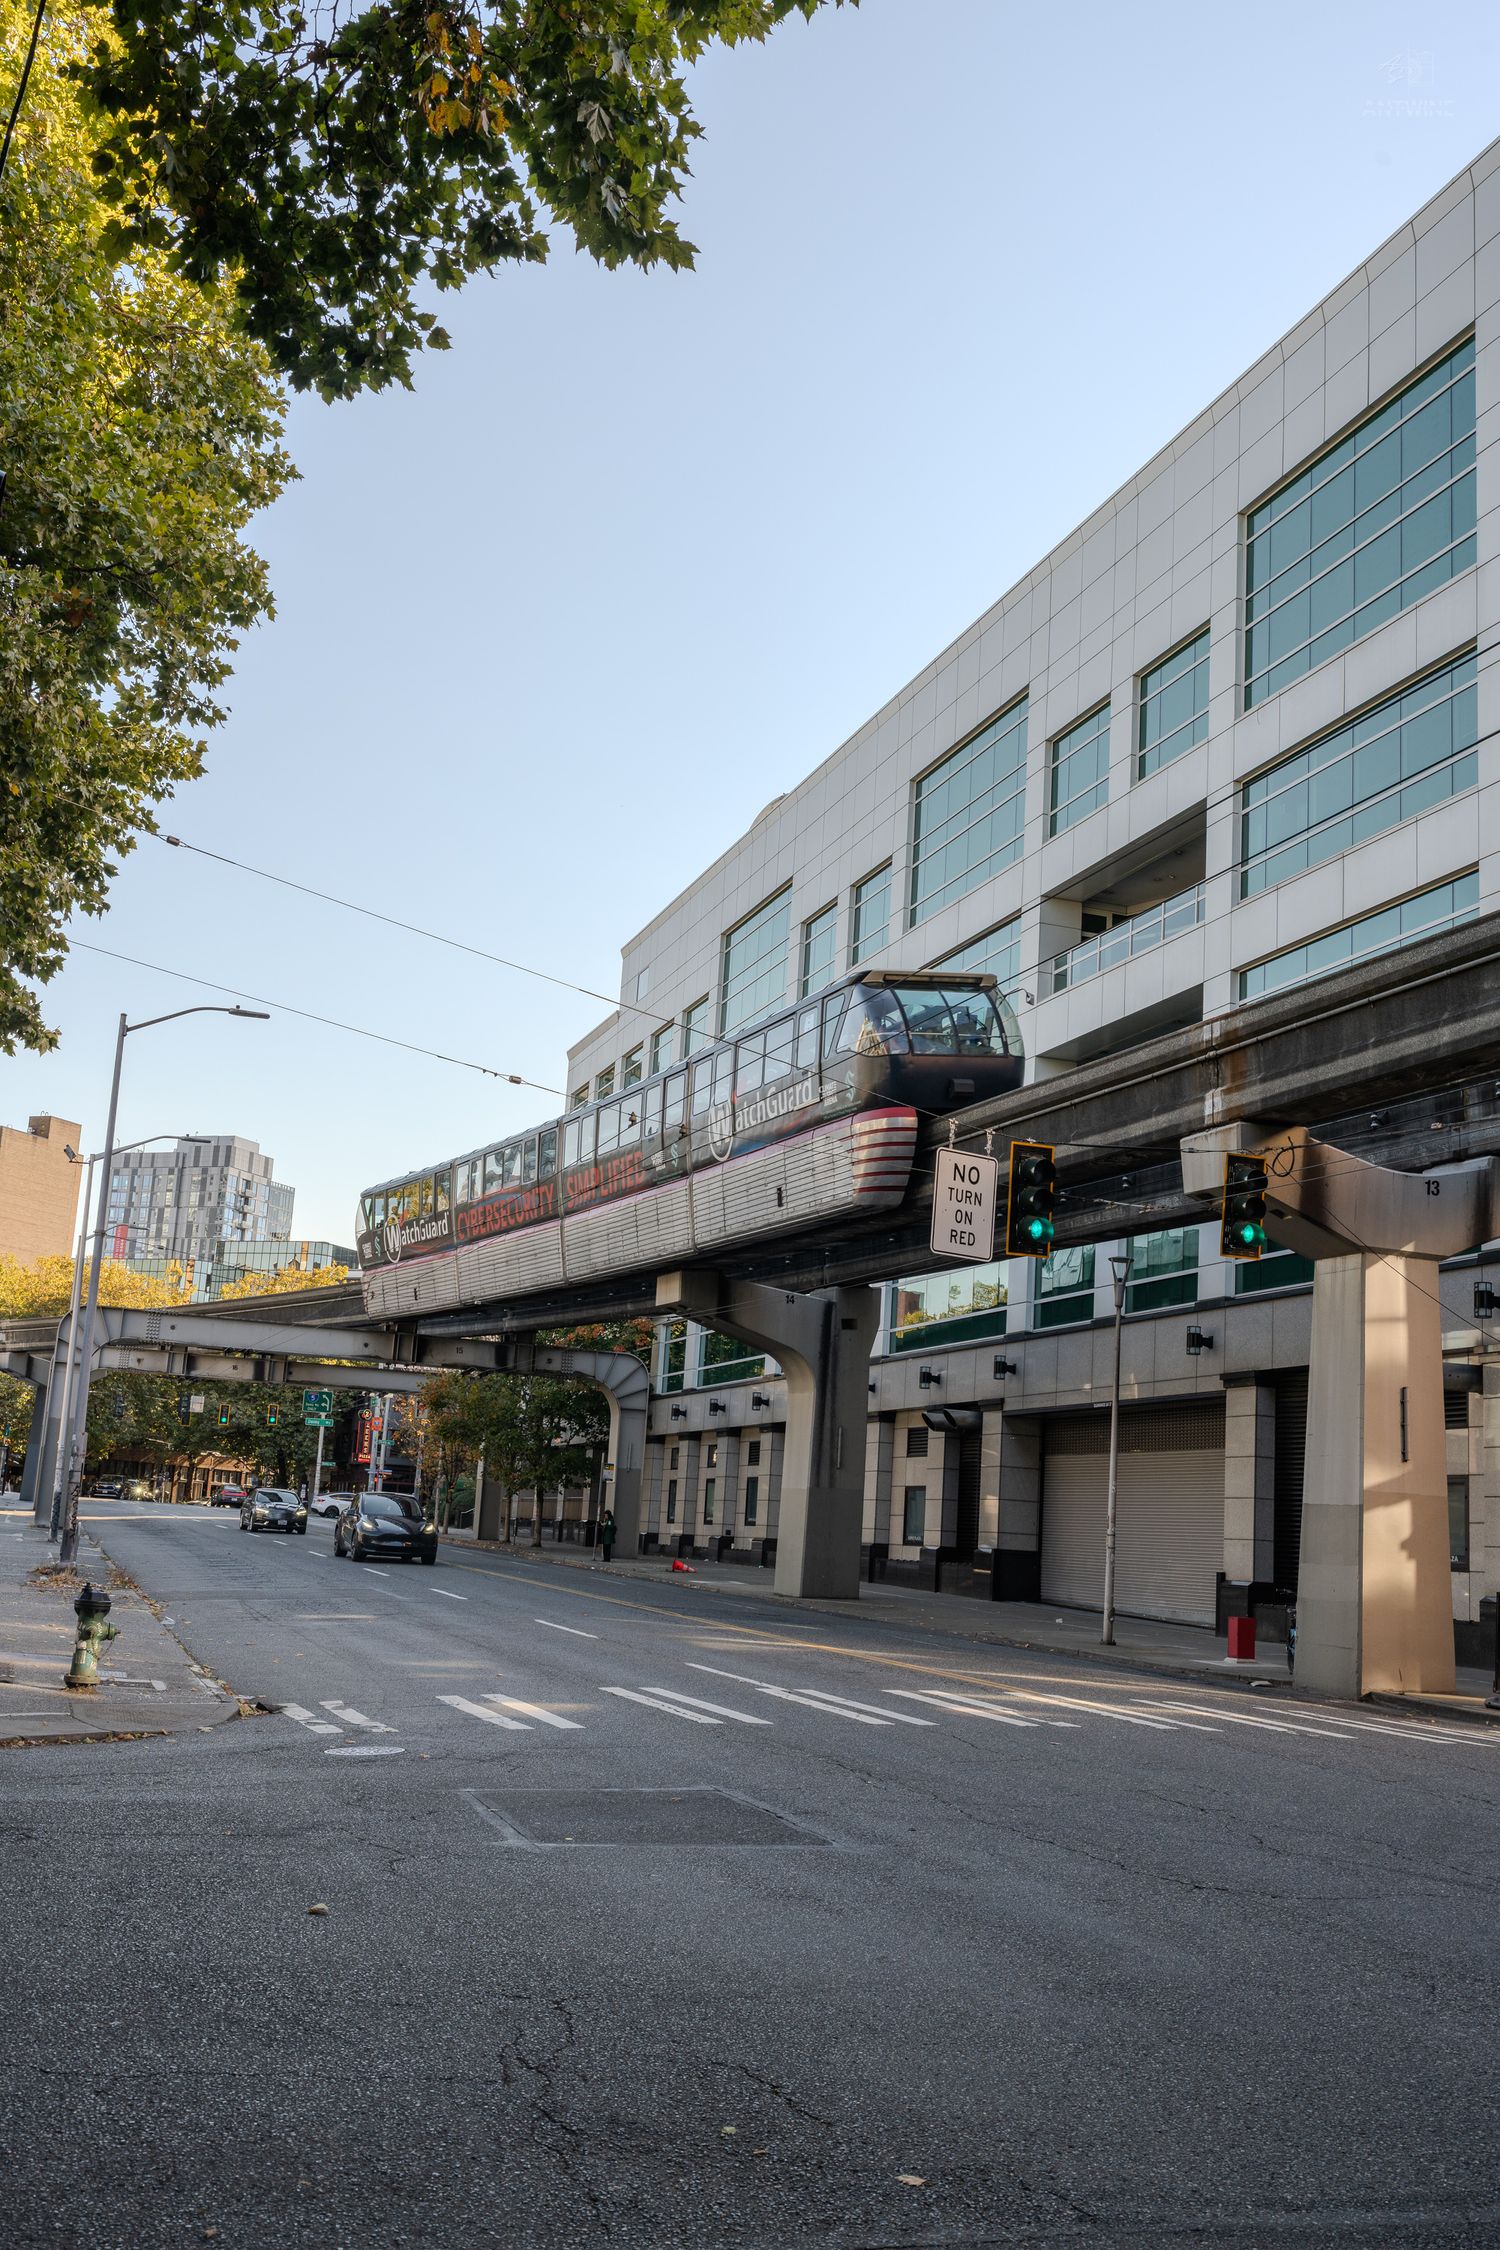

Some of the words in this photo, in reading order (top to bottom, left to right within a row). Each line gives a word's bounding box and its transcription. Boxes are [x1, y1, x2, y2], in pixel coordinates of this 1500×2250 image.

[710, 1070, 813, 1150] WatchGuard
[953, 1163, 980, 1185] NO
[457, 1183, 555, 1240] CYBERSECURITY
[567, 1151, 645, 1209] SIMPLIFIED
[948, 1187, 983, 1207] TURN
[1424, 1179, 1440, 1196] 13
[955, 1209, 973, 1226] ON
[385, 1212, 449, 1254] WatchGuard
[950, 1229, 976, 1247] RED
[785, 1294, 795, 1305] 14
